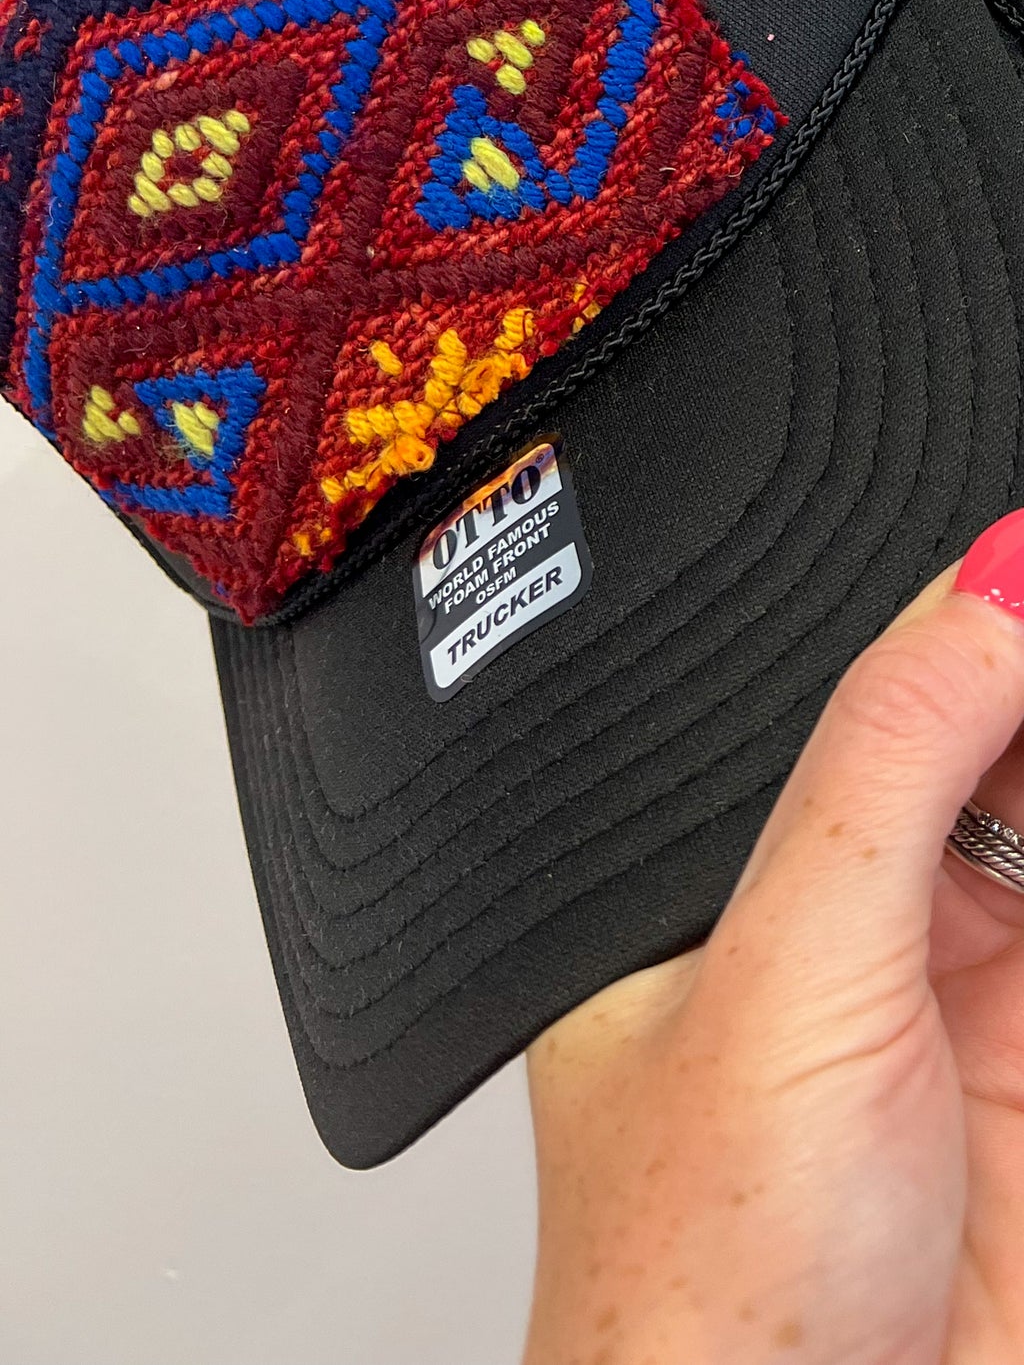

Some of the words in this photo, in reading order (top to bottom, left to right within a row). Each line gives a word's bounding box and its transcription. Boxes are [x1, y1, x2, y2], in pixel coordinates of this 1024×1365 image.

[428, 556, 484, 610] WORLD
[487, 500, 560, 561] FAMOUS
[432, 465, 541, 571] OTTO
[444, 569, 489, 615] FOAM
[492, 523, 551, 575] FRONT
[447, 565, 564, 666] TRUCKER
[475, 566, 517, 605] OSFM
